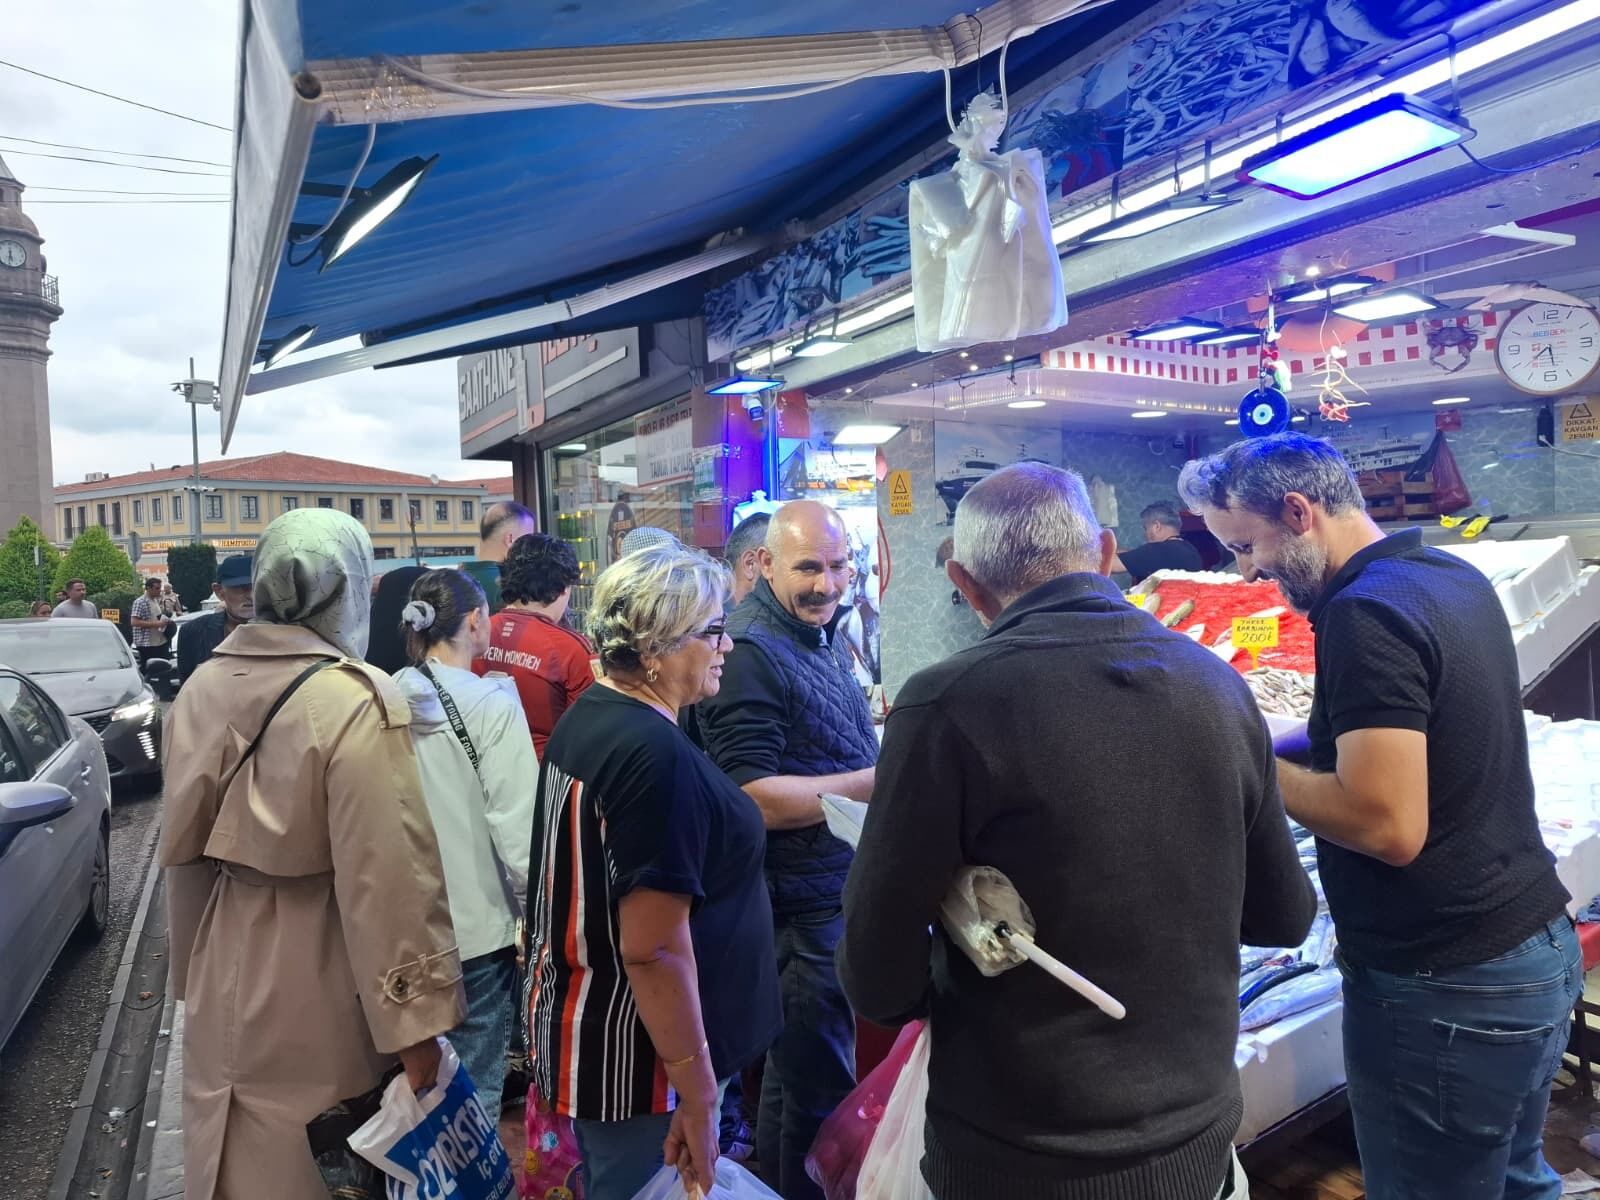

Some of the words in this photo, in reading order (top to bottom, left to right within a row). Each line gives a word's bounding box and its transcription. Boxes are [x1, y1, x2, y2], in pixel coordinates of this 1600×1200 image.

[1543, 309, 1559, 320] 12
[1579, 336, 1593, 348] 3
[1508, 344, 1521, 355] 9
[1543, 370, 1558, 382] 6
[445, 703, 463, 732] YOUNG
